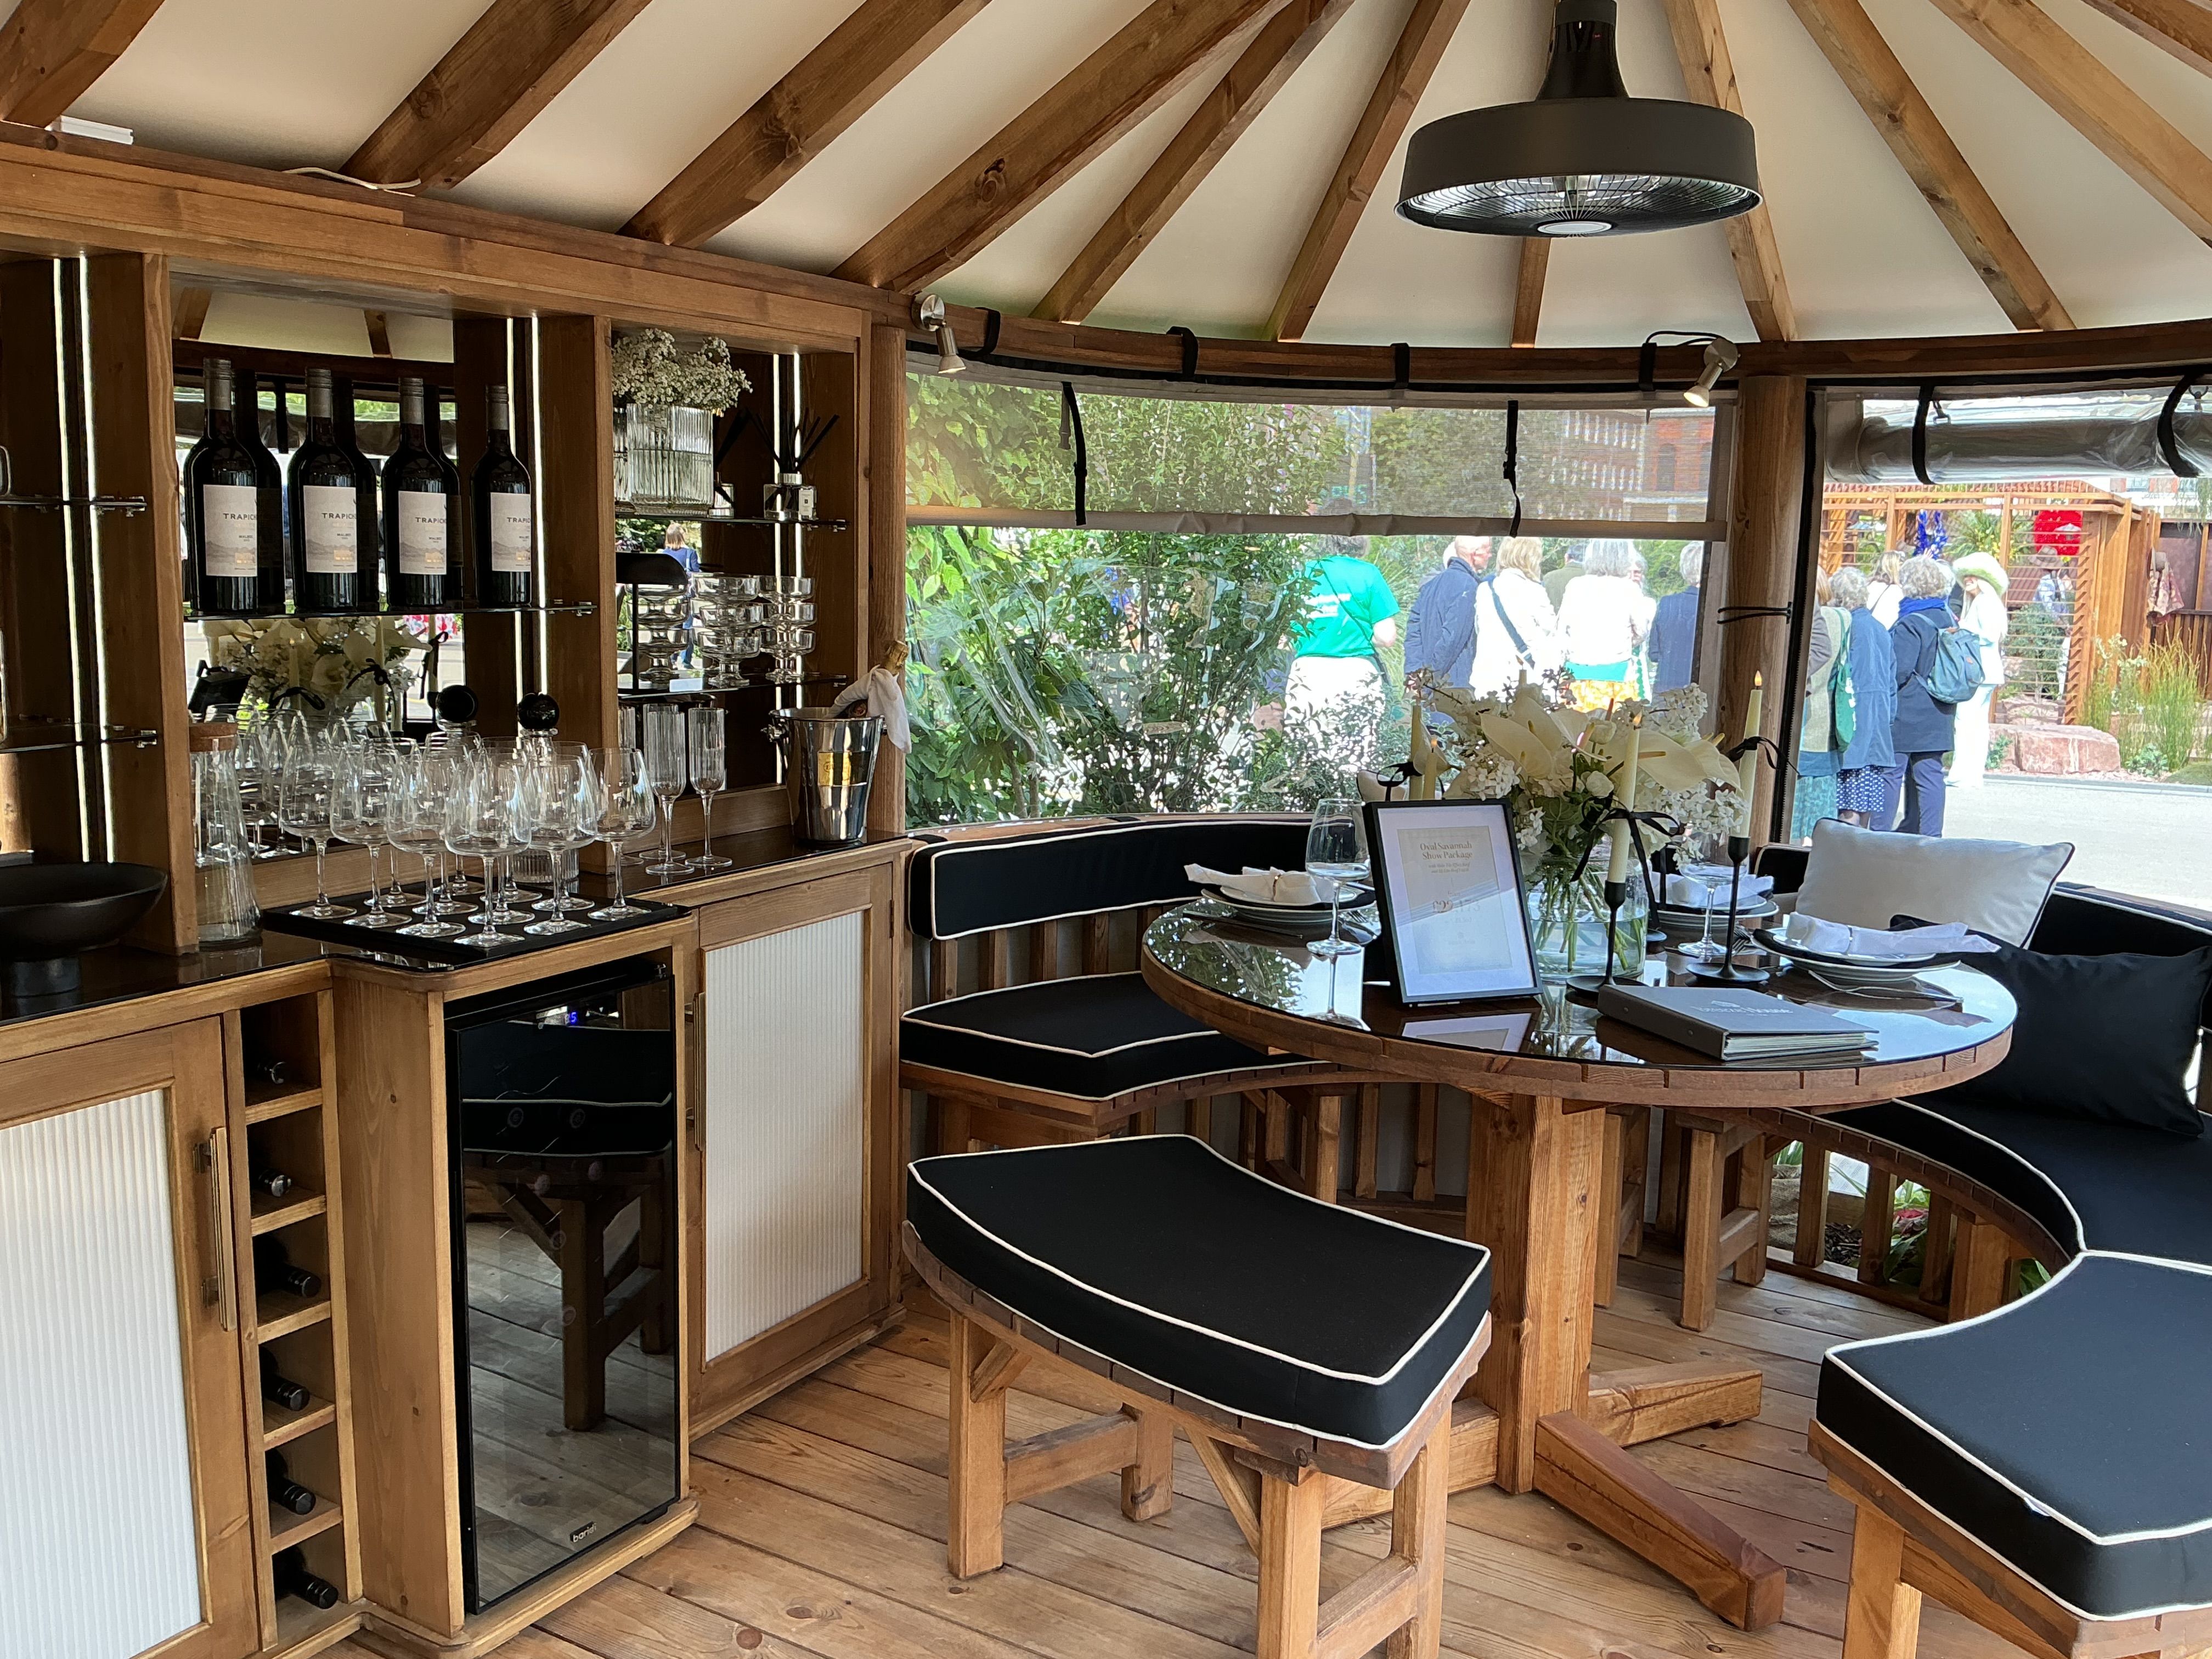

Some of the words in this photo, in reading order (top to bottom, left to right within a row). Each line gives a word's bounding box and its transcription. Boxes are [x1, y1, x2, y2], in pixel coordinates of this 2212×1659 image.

[1420, 842, 1437, 850] Oval
[1437, 841, 1472, 850] Savannah
[1422, 851, 1442, 860] Show
[1443, 850, 1473, 860] Package
[573, 1522, 597, 1543] baridi
